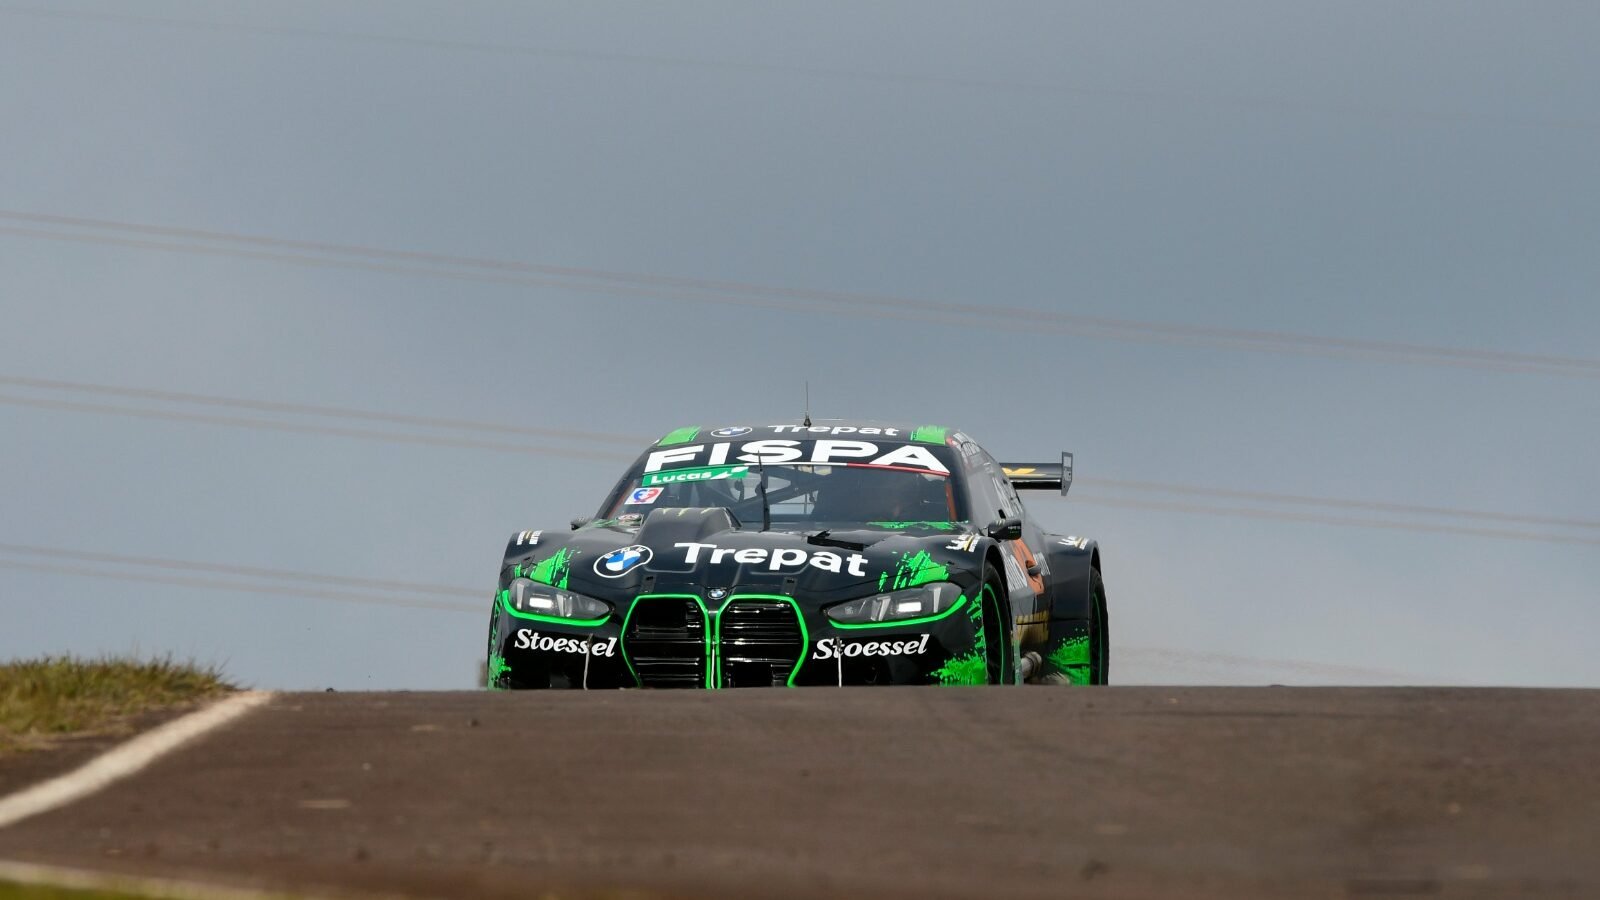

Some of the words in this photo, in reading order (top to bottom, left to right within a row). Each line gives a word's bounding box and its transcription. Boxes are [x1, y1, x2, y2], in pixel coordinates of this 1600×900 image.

[768, 424, 900, 436] Trepat
[644, 439, 950, 474] FISPA
[651, 471, 712, 484] Lucas
[674, 542, 868, 576] Trepat
[514, 628, 617, 657] Stoessel
[812, 634, 930, 660] Stoessel
